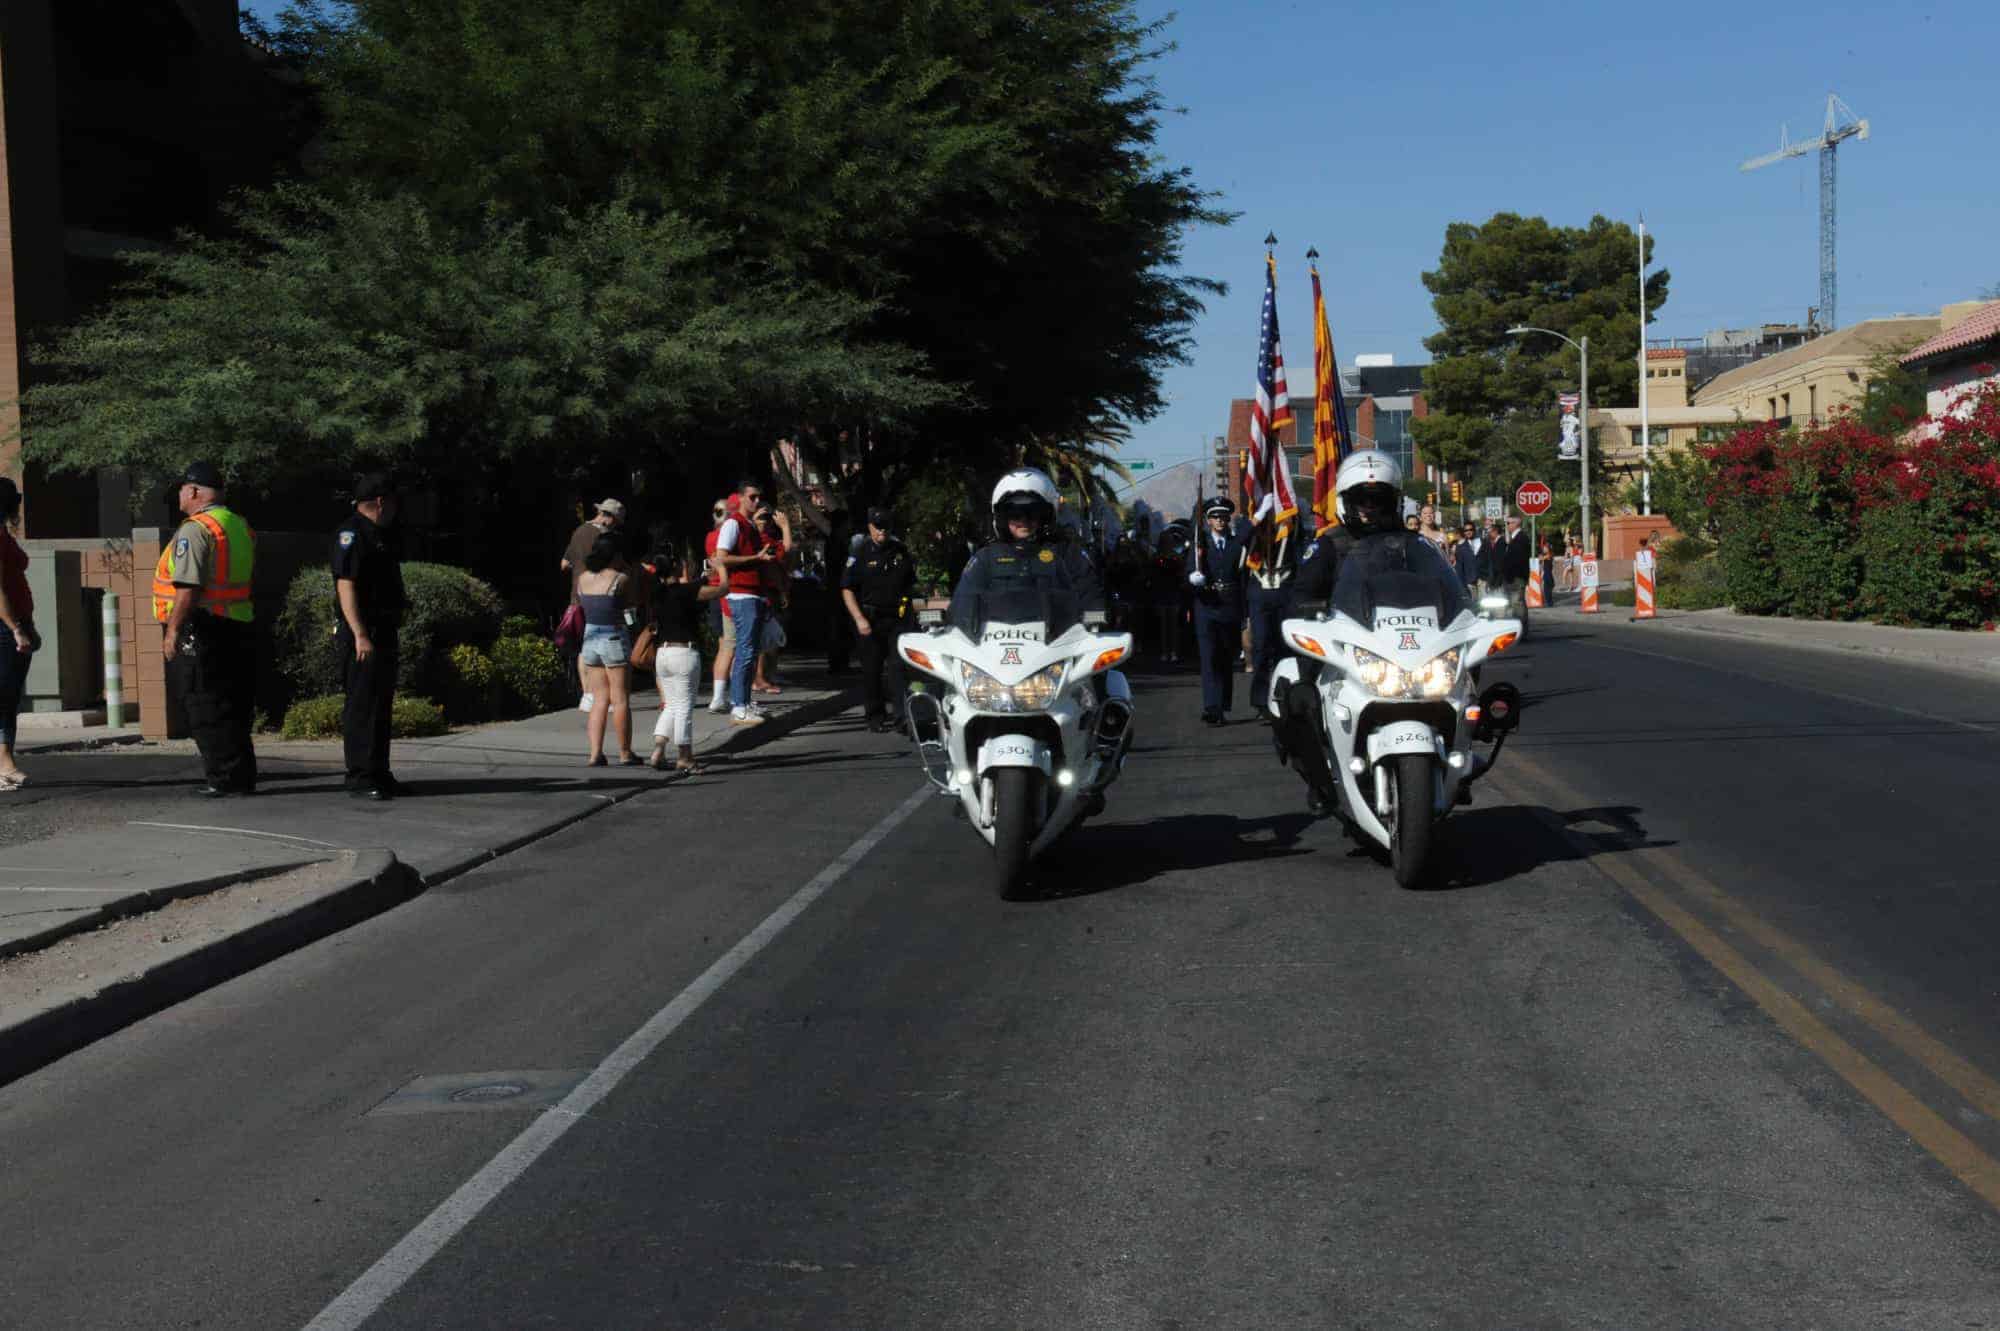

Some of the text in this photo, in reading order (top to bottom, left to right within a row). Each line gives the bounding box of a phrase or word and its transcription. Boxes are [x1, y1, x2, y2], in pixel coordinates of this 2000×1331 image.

[1519, 491, 1549, 505] STOP
[1488, 508, 1500, 517] 20
[1376, 615, 1433, 629] POLICE
[983, 629, 1042, 642] POLICE
[1399, 632, 1421, 650] A
[1000, 647, 1022, 665] A
